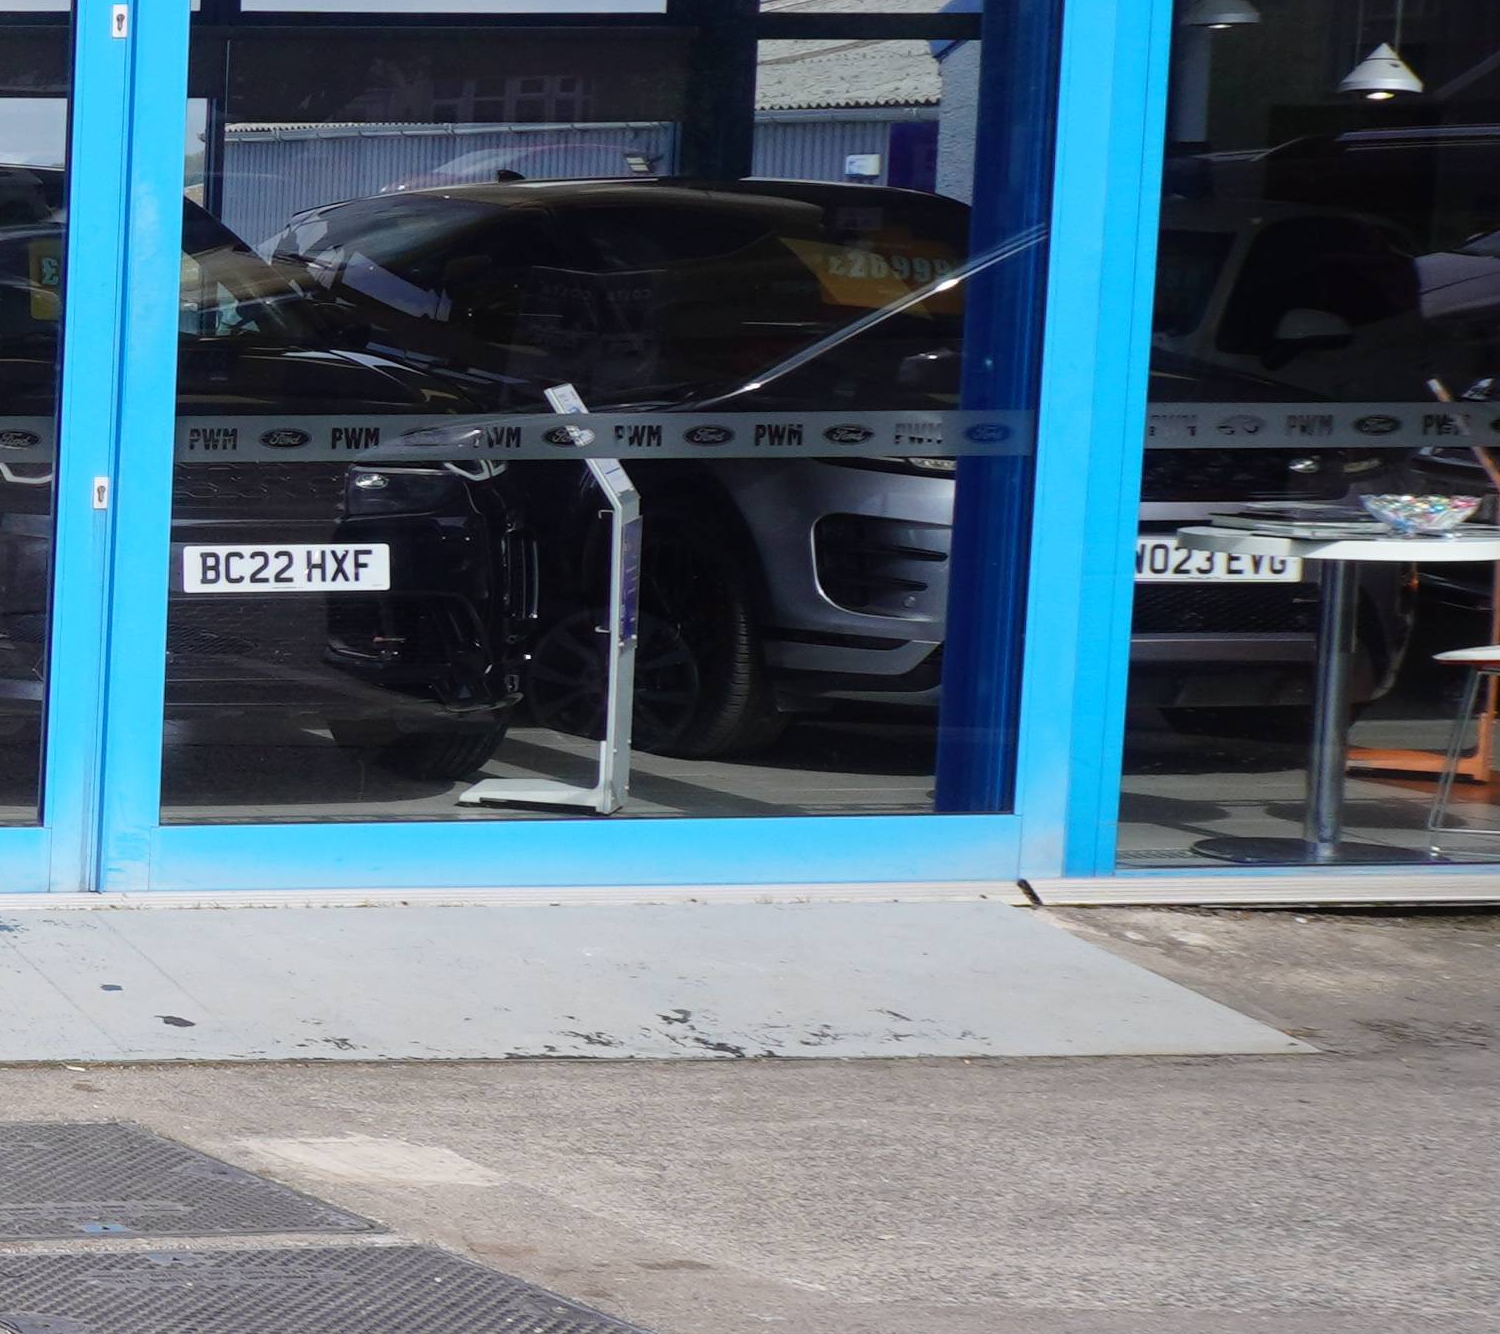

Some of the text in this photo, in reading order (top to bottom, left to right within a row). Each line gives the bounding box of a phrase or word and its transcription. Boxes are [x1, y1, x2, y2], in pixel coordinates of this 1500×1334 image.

[262, 430, 309, 447] Ford
[331, 427, 380, 449] PWM
[686, 427, 732, 445] Ford
[755, 424, 803, 446] PWM
[200, 549, 373, 585] BC22 HXF
